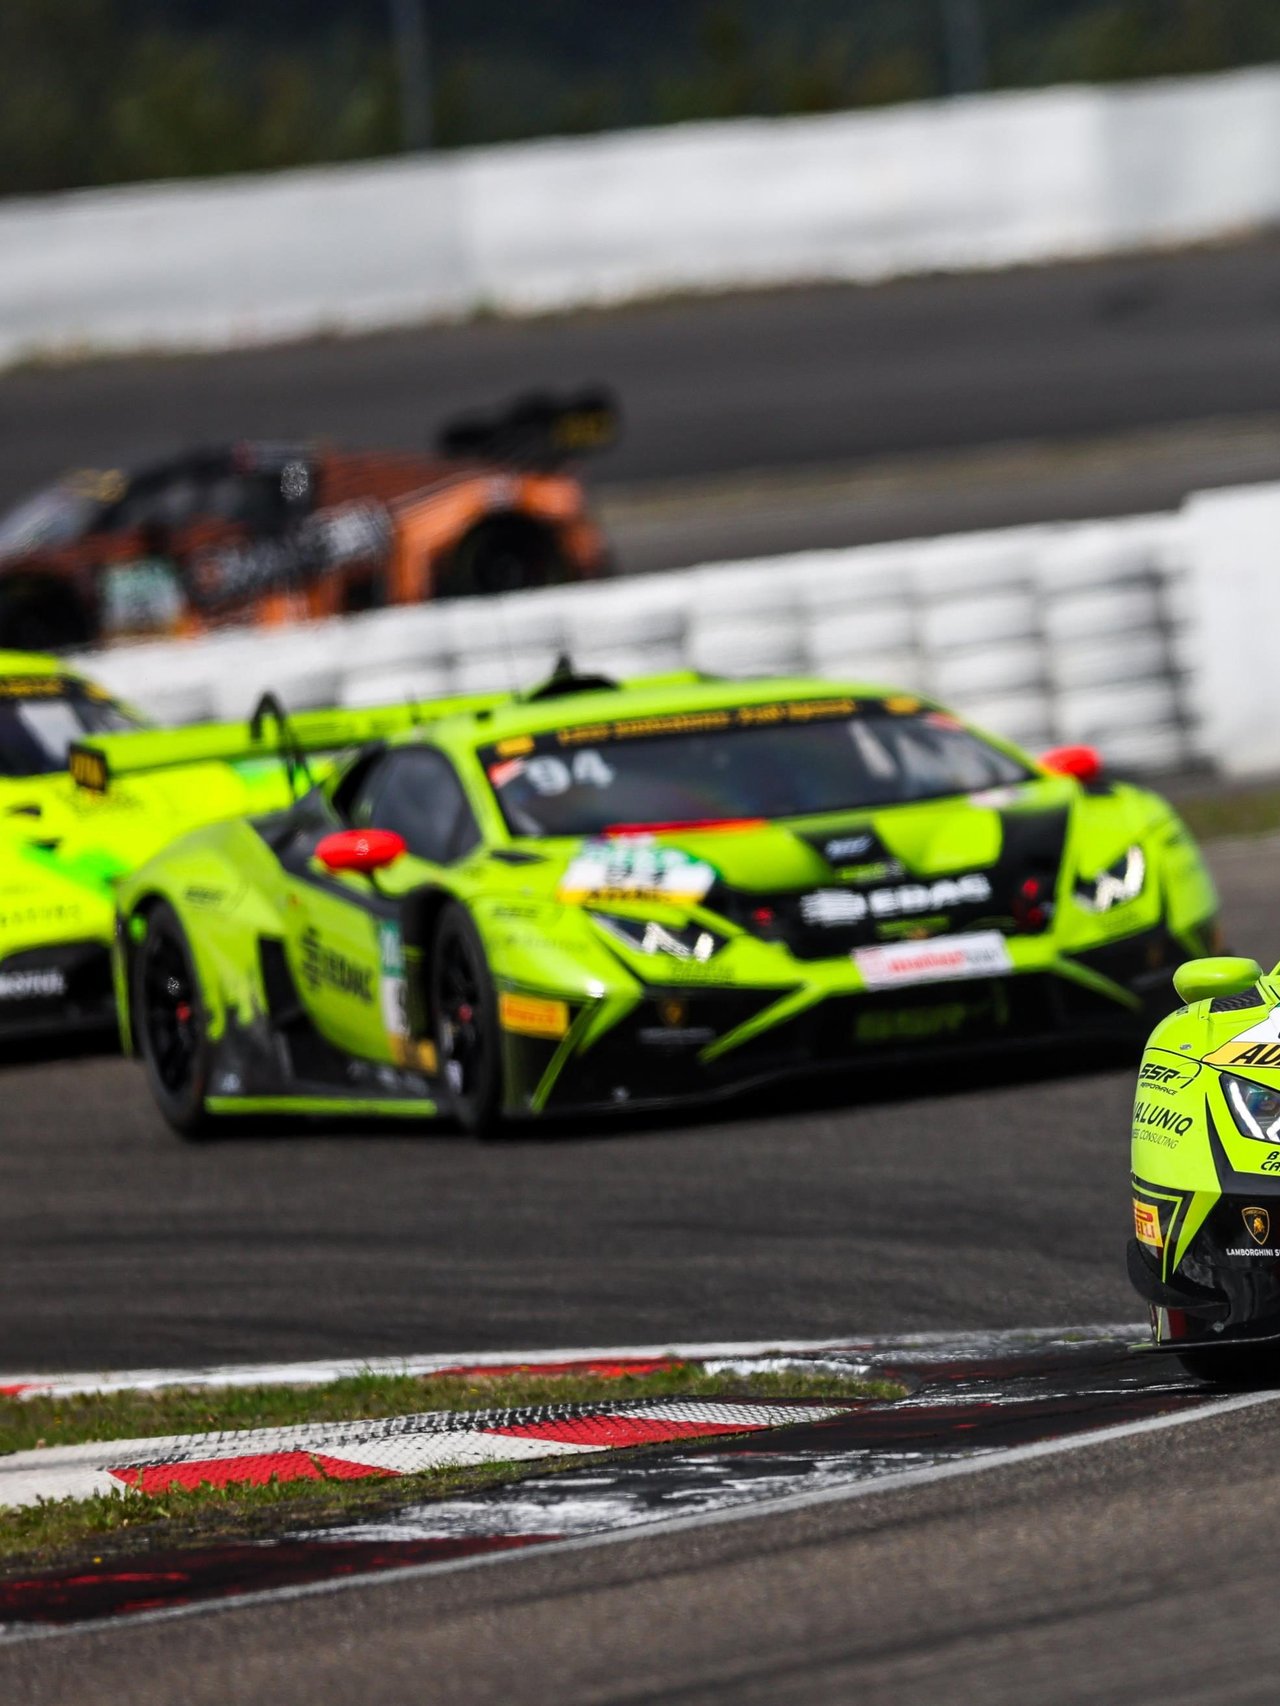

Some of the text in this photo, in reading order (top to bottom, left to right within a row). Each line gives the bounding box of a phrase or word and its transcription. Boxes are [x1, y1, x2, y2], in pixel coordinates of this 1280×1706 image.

[526, 750, 615, 797] 94
[1140, 1129, 1179, 1149] CONSULTING
[1226, 1248, 1273, 1257] LAMBORGHINI
